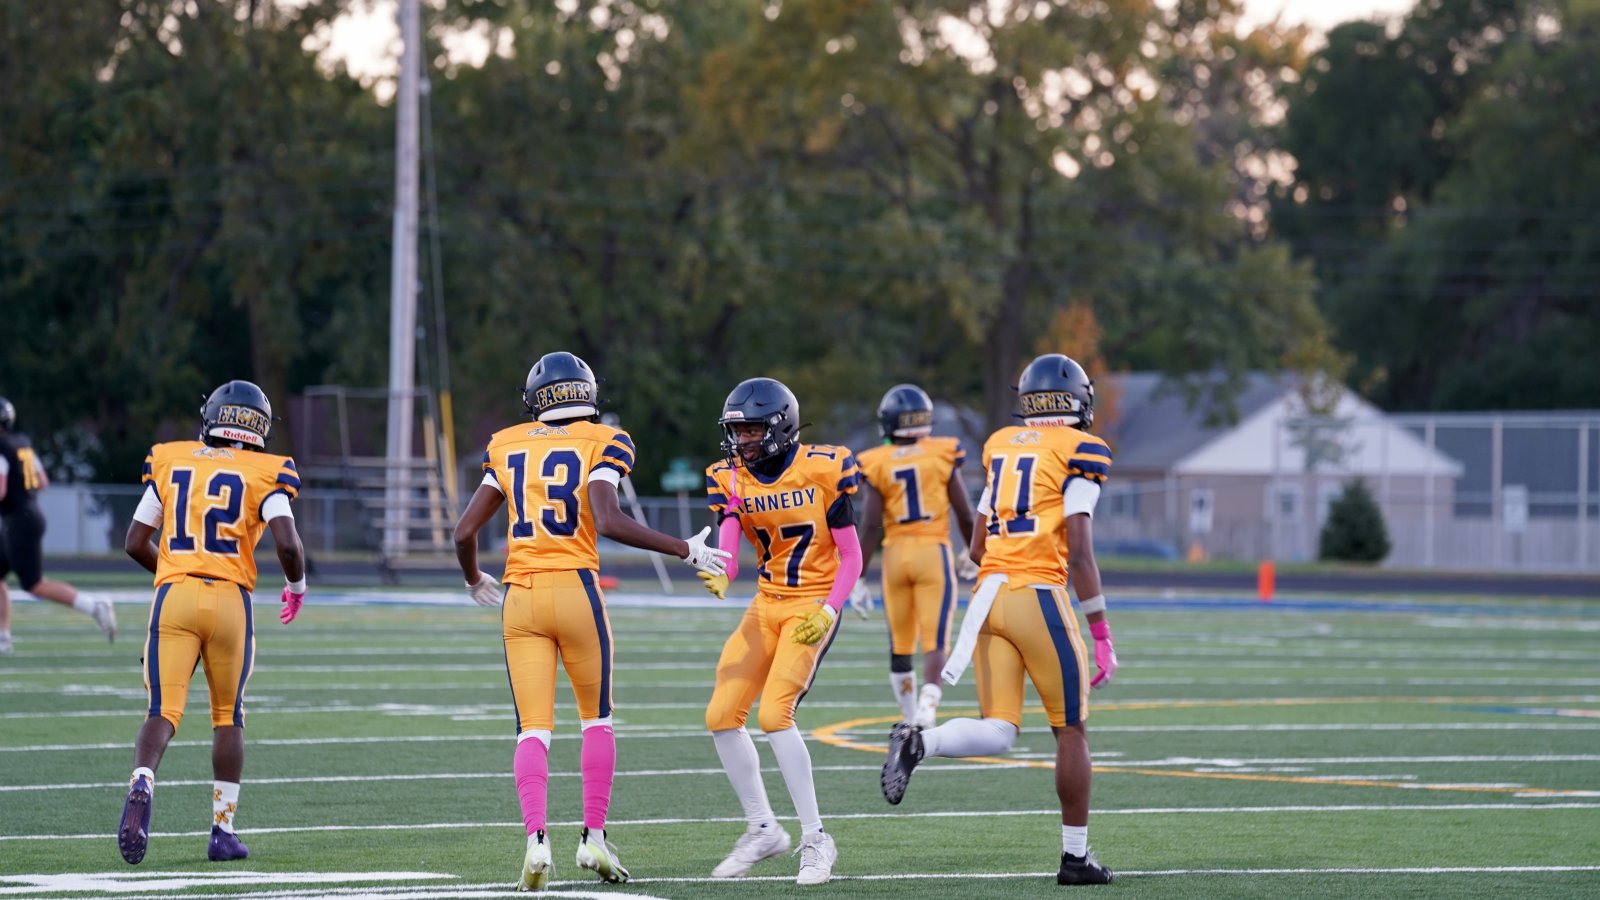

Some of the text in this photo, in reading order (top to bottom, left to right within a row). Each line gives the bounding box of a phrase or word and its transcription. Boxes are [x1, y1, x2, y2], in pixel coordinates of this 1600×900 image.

[218, 404, 269, 437] EAGLES
[536, 381, 591, 410] EAGLES
[223, 429, 257, 442] Riddell
[166, 466, 247, 558] 12
[505, 447, 584, 541] 13
[891, 463, 936, 525] 1
[986, 453, 1040, 539] 11
